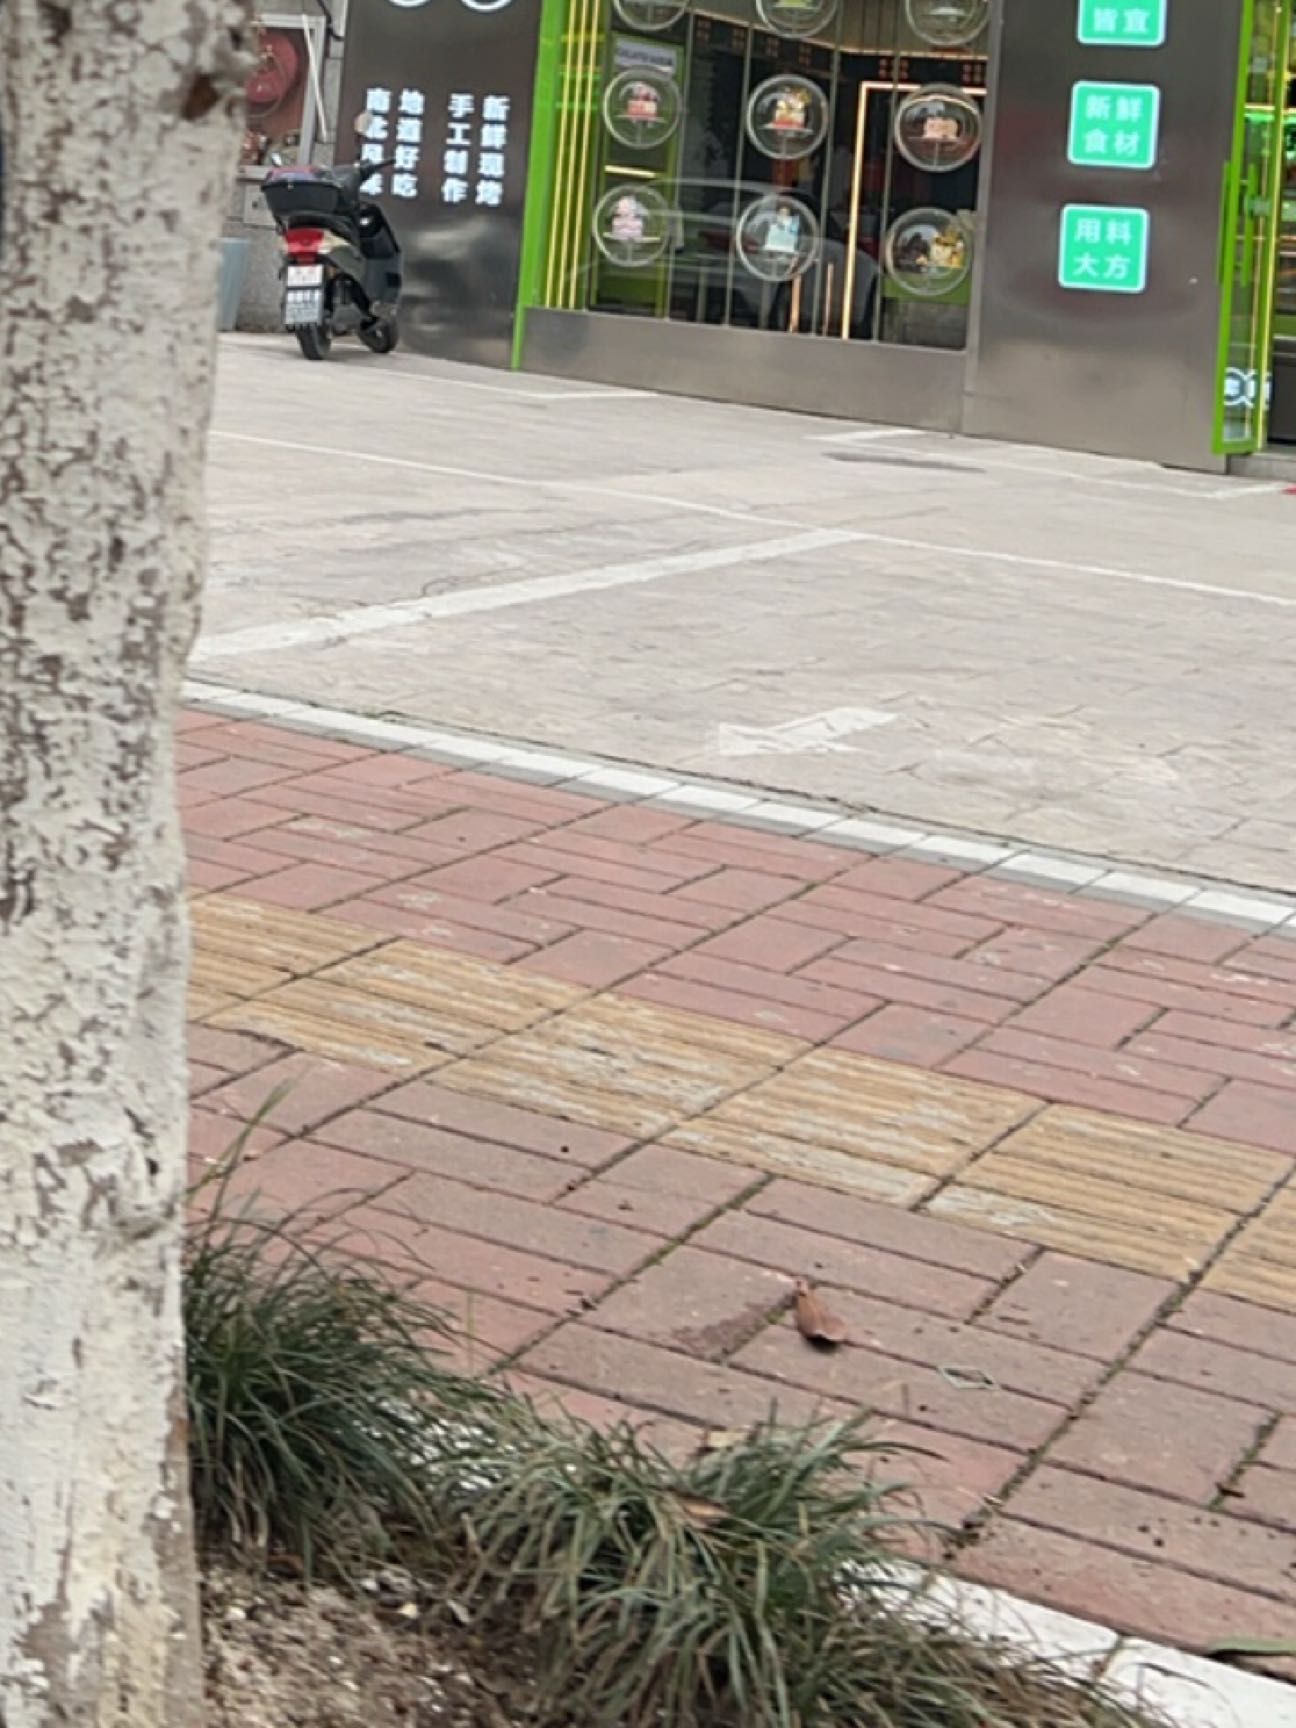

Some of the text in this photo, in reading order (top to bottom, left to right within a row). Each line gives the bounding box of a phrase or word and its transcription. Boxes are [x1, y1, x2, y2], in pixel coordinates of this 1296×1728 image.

[1093, 8, 1151, 35] 皆宜
[1084, 95, 1144, 122] 新鲜
[1083, 129, 1142, 158] 食材
[1075, 218, 1133, 246] 用料
[1073, 253, 1132, 280] 大方
